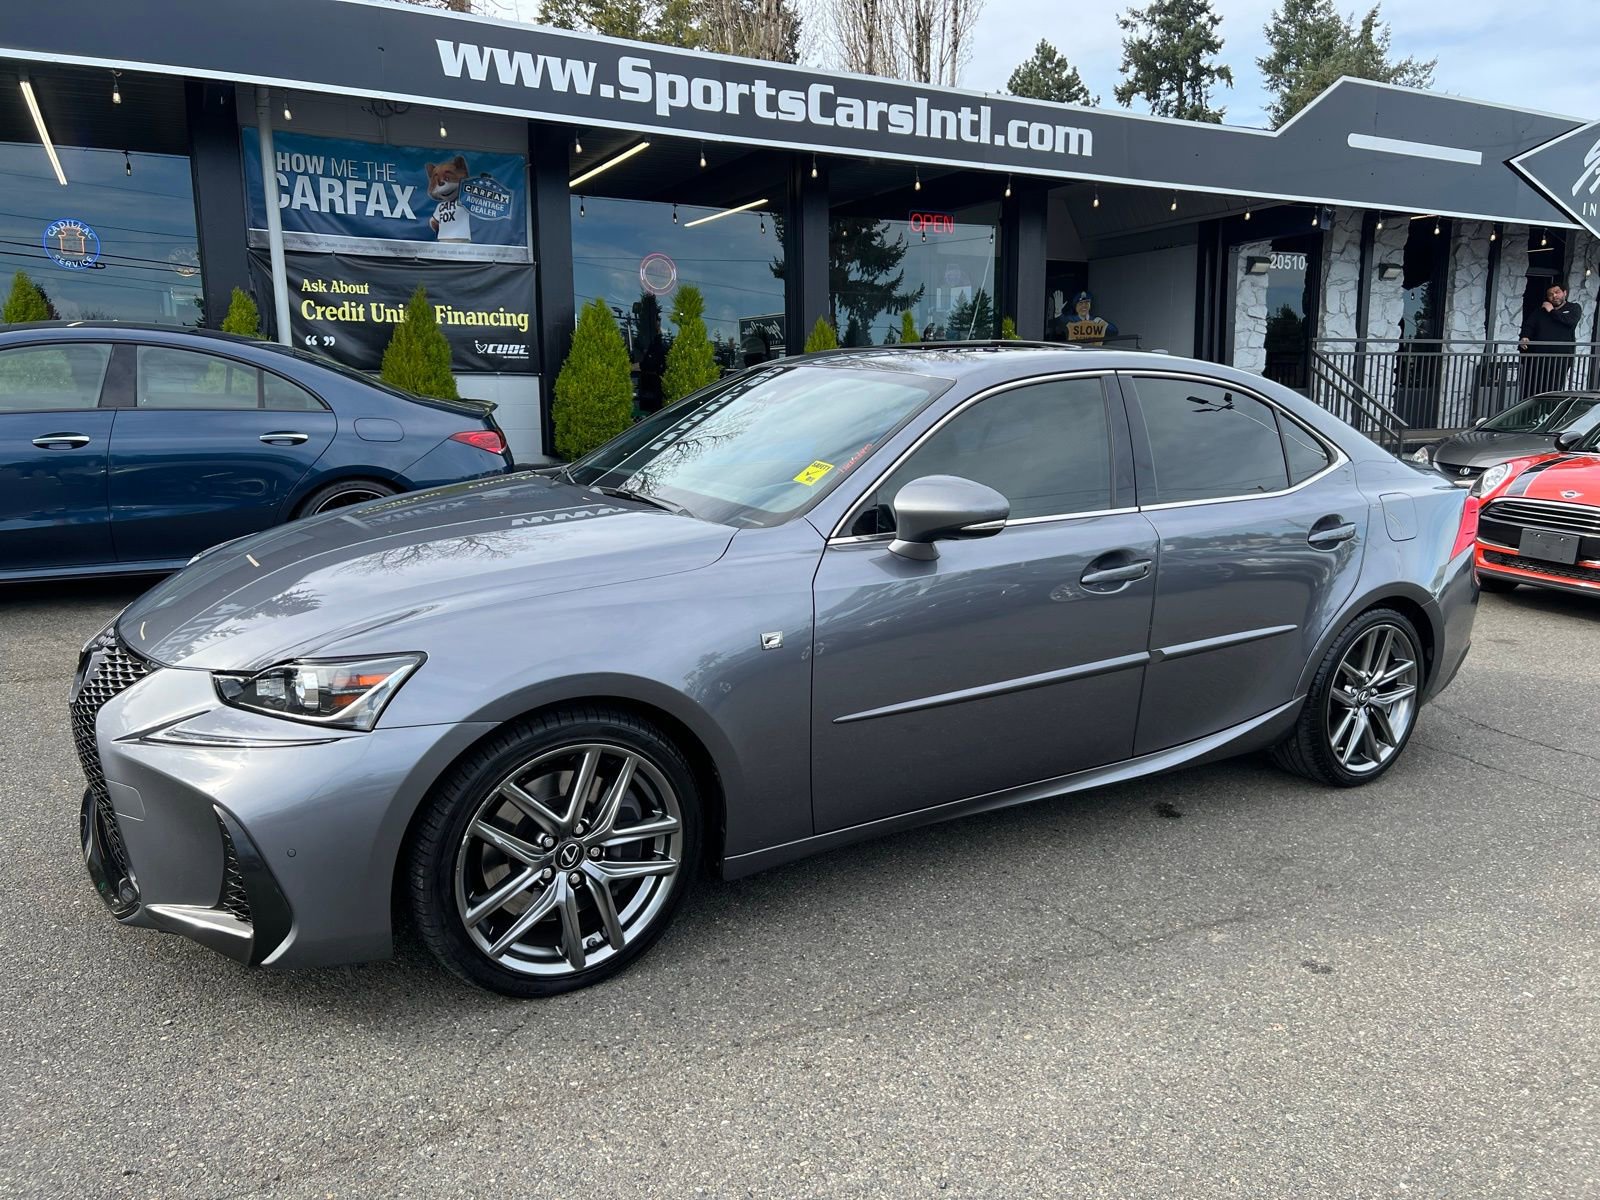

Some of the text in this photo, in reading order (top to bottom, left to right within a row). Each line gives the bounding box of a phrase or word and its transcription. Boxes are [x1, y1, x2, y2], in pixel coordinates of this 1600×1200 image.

[276, 151, 397, 182] HOW ME THE
[275, 172, 417, 220] CARFAX
[464, 185, 509, 203] CARFAX
[439, 201, 457, 212] CAR
[466, 196, 504, 211] ADVANTAGE
[470, 205, 497, 217] DEALER
[439, 211, 456, 223] FOX
[911, 213, 954, 234] OPEN
[47, 220, 92, 240] CADILLAC
[53, 254, 93, 269] SERVICE
[1270, 253, 1306, 270] 20510
[301, 279, 369, 295] Ask About
[301, 299, 529, 332] Credit Uni Financing
[1073, 325, 1104, 336] SLOW
